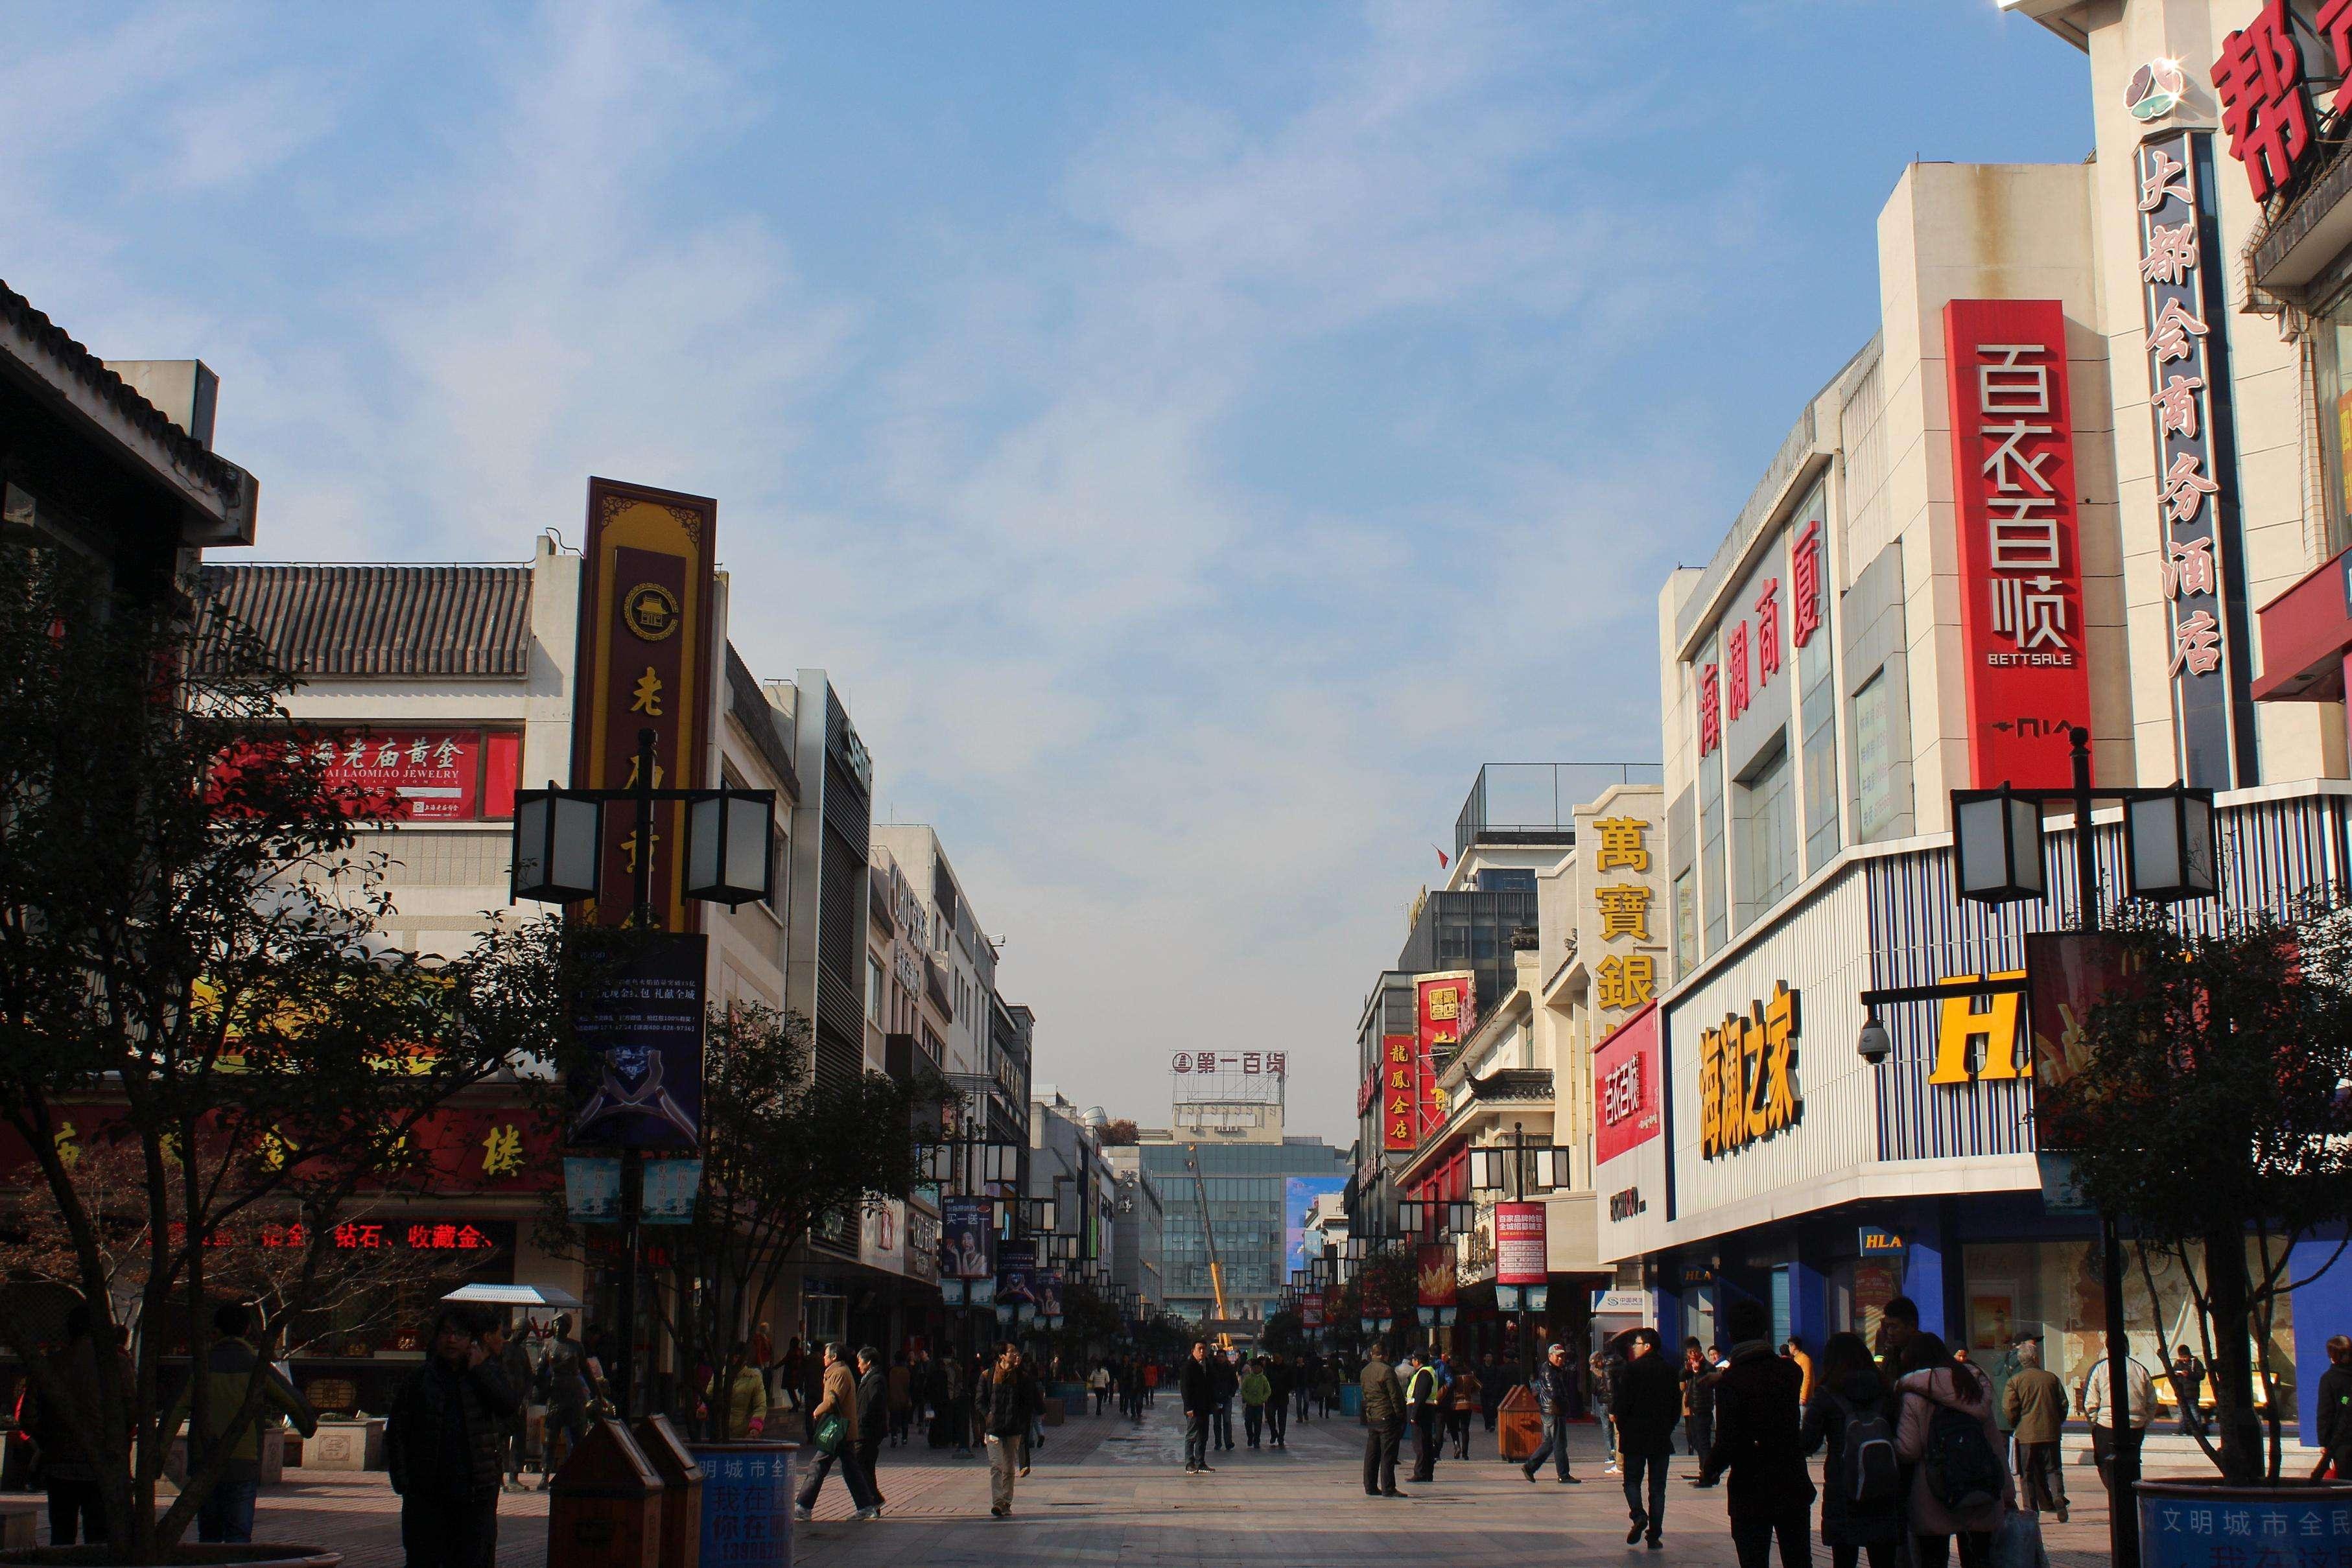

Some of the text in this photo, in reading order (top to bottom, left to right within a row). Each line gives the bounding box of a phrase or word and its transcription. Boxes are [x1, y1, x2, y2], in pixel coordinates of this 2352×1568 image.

[2138, 150, 2220, 679] 大都会商务酒店
[1977, 344, 2068, 648] 百衣百顺
[1701, 521, 1820, 757] 海澜商厦
[1988, 653, 2072, 666] BETTSALE
[344, 769, 399, 778] LAOMIAO
[403, 769, 460, 778] JEWELRY
[1592, 816, 1652, 1041] 萬寶銀
[1197, 1052, 1285, 1074] 第一百货
[1389, 1044, 1411, 1140] 龍鳳金店
[1605, 1053, 1639, 1126] 百衣百顺
[1699, 980, 1797, 1160] 海澜之家
[946, 1213, 989, 1224] 买一送一
[1865, 1234, 1903, 1249] HLA
[2162, 1508, 2351, 1537] 文明城市全民
